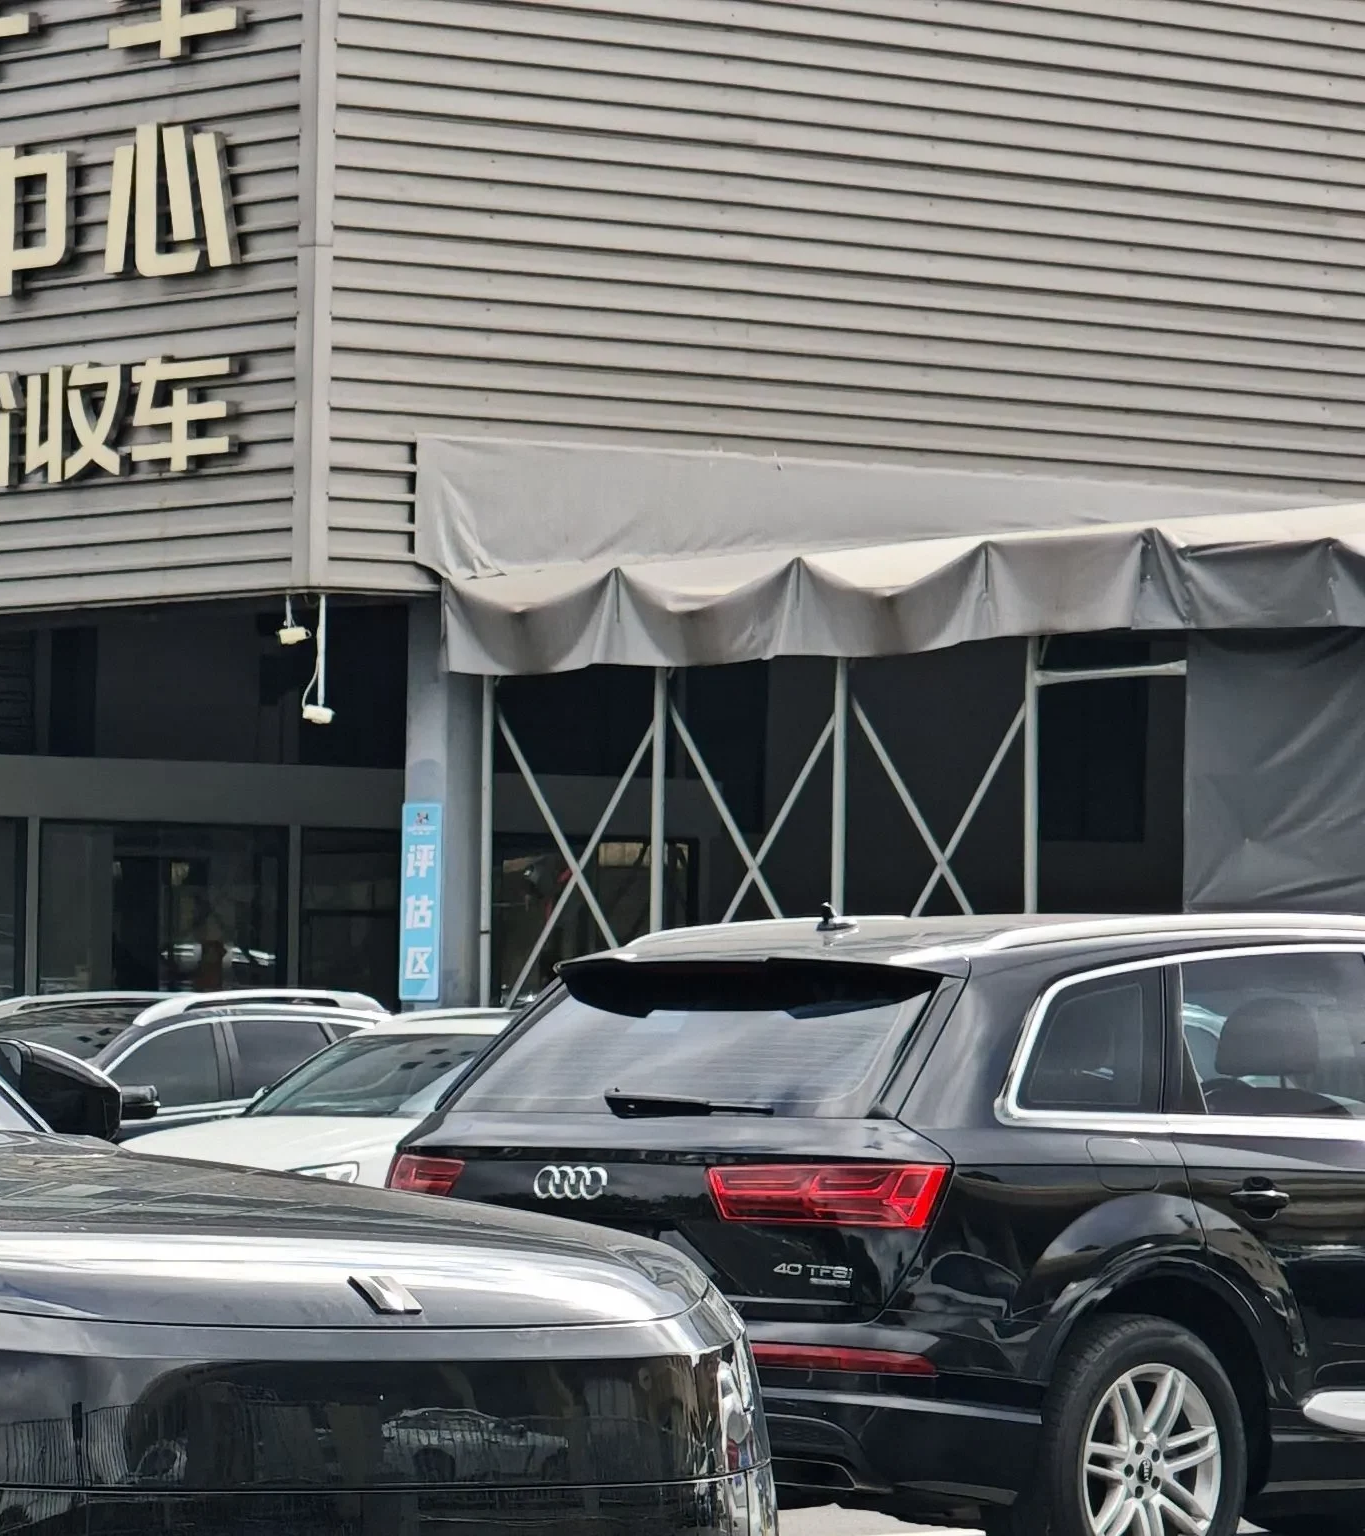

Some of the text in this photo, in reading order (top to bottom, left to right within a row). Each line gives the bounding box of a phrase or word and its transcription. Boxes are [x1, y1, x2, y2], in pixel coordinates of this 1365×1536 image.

[405, 844, 436, 981] 评估区
[773, 1262, 803, 1276] 40
